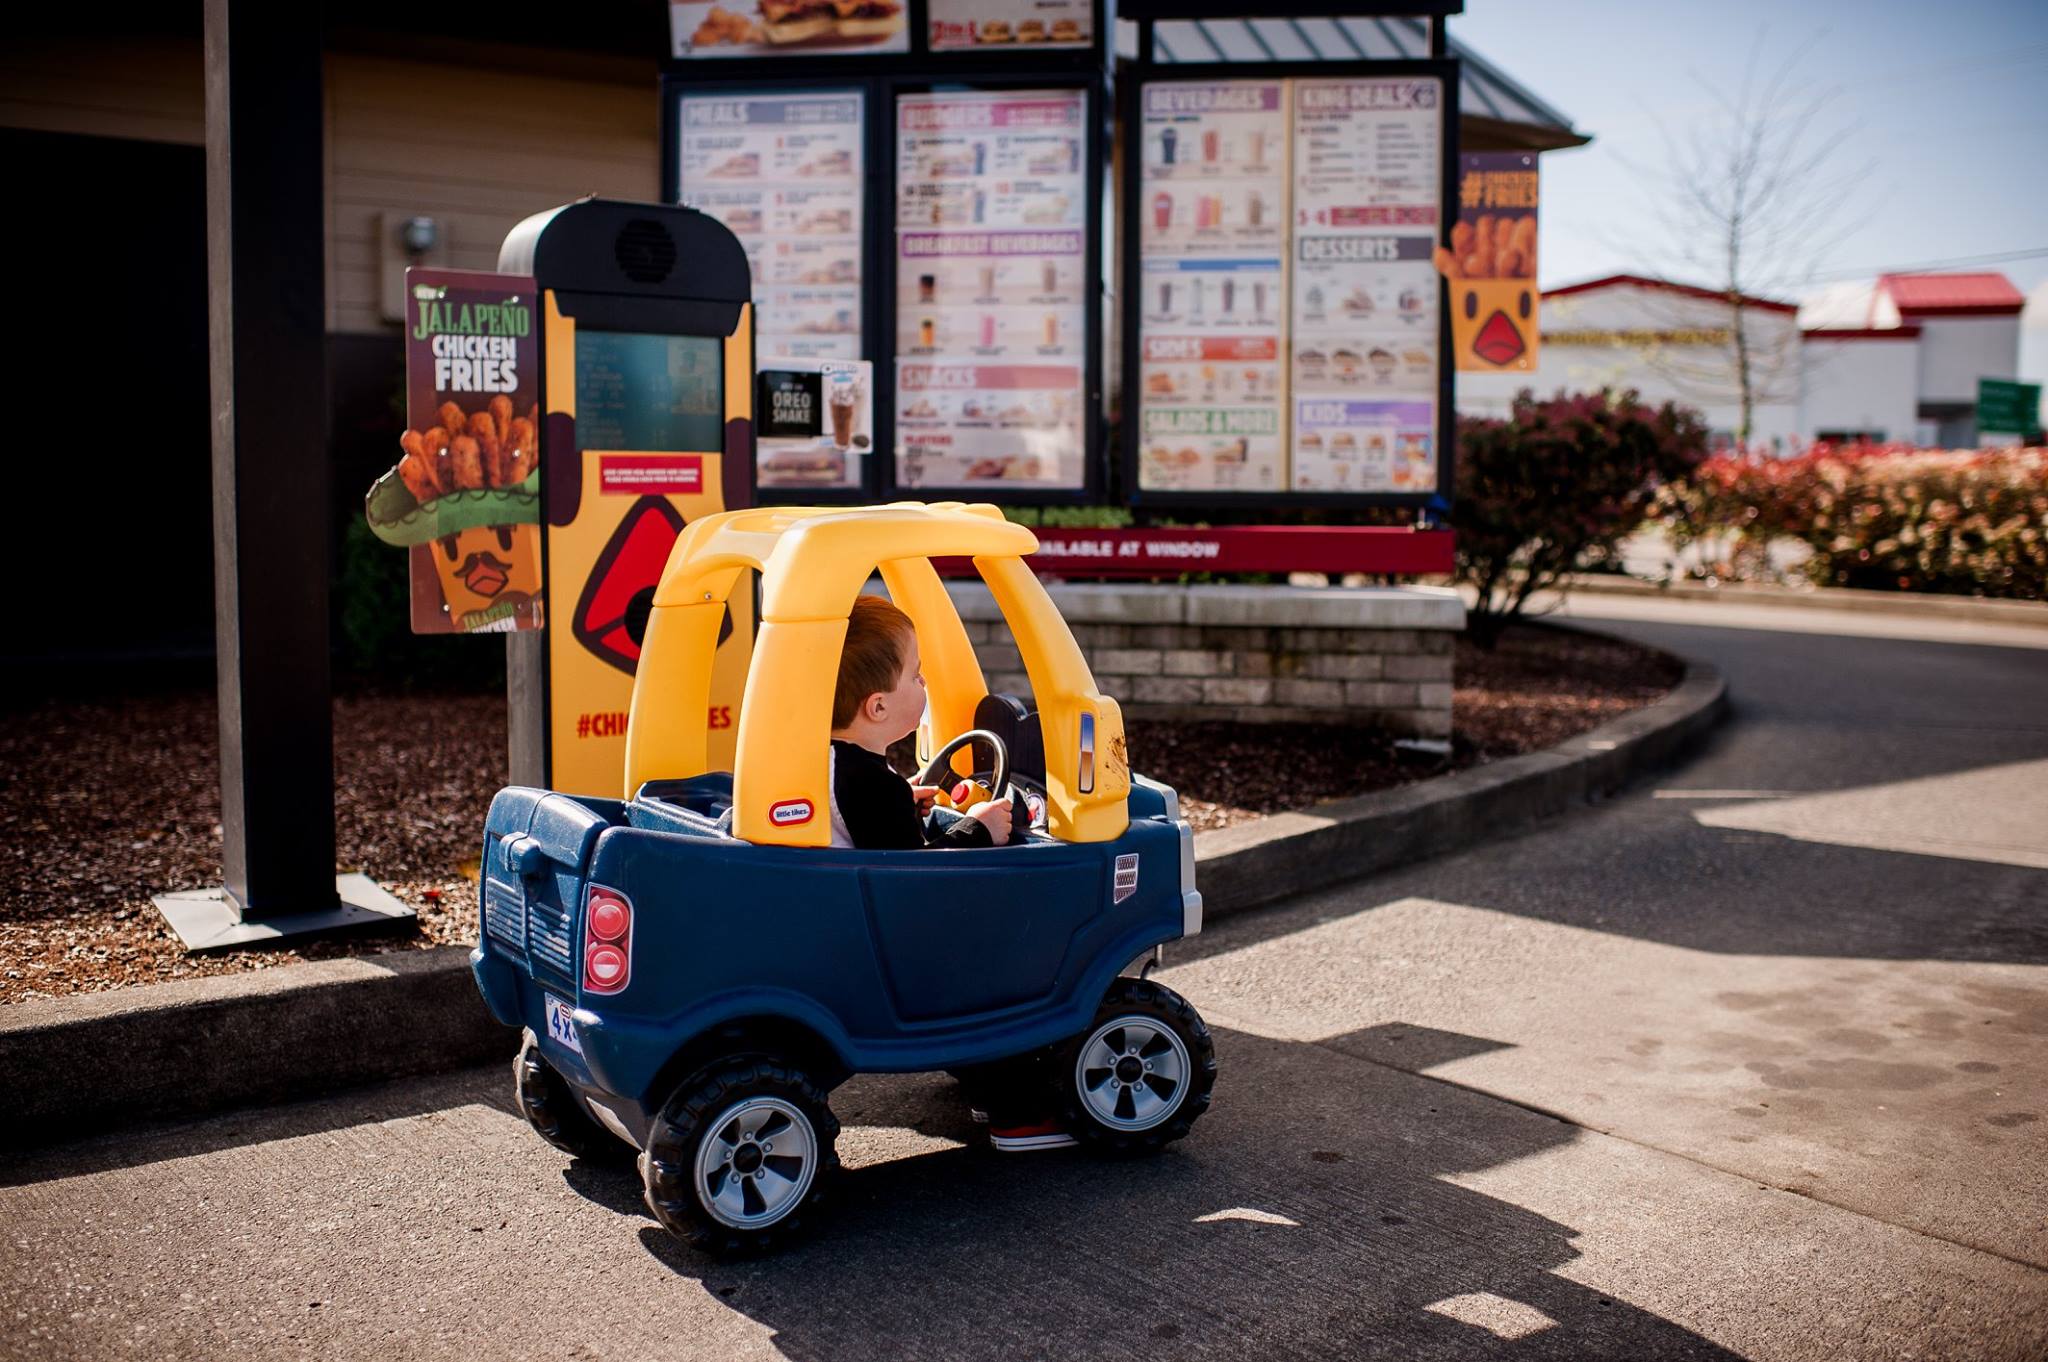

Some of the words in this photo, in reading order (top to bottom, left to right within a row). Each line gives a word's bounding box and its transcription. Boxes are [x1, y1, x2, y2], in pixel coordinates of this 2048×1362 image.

[685, 104, 748, 126] MEALS
[990, 232, 1080, 254] BEVERAGES
[1302, 238, 1398, 260] DESSERTS
[413, 299, 529, 340] JALAPEÑO
[432, 334, 517, 360] CHICKEN
[434, 358, 518, 393] FRIES
[904, 365, 976, 388] SNACKS
[772, 391, 811, 408] OREO
[772, 408, 810, 424] SHAKE
[1303, 402, 1346, 424] KIDS
[1037, 540, 1114, 557] AILABLE
[1118, 541, 1141, 557] AT
[1145, 542, 1220, 558] WINDOW
[775, 809, 790, 818] little
